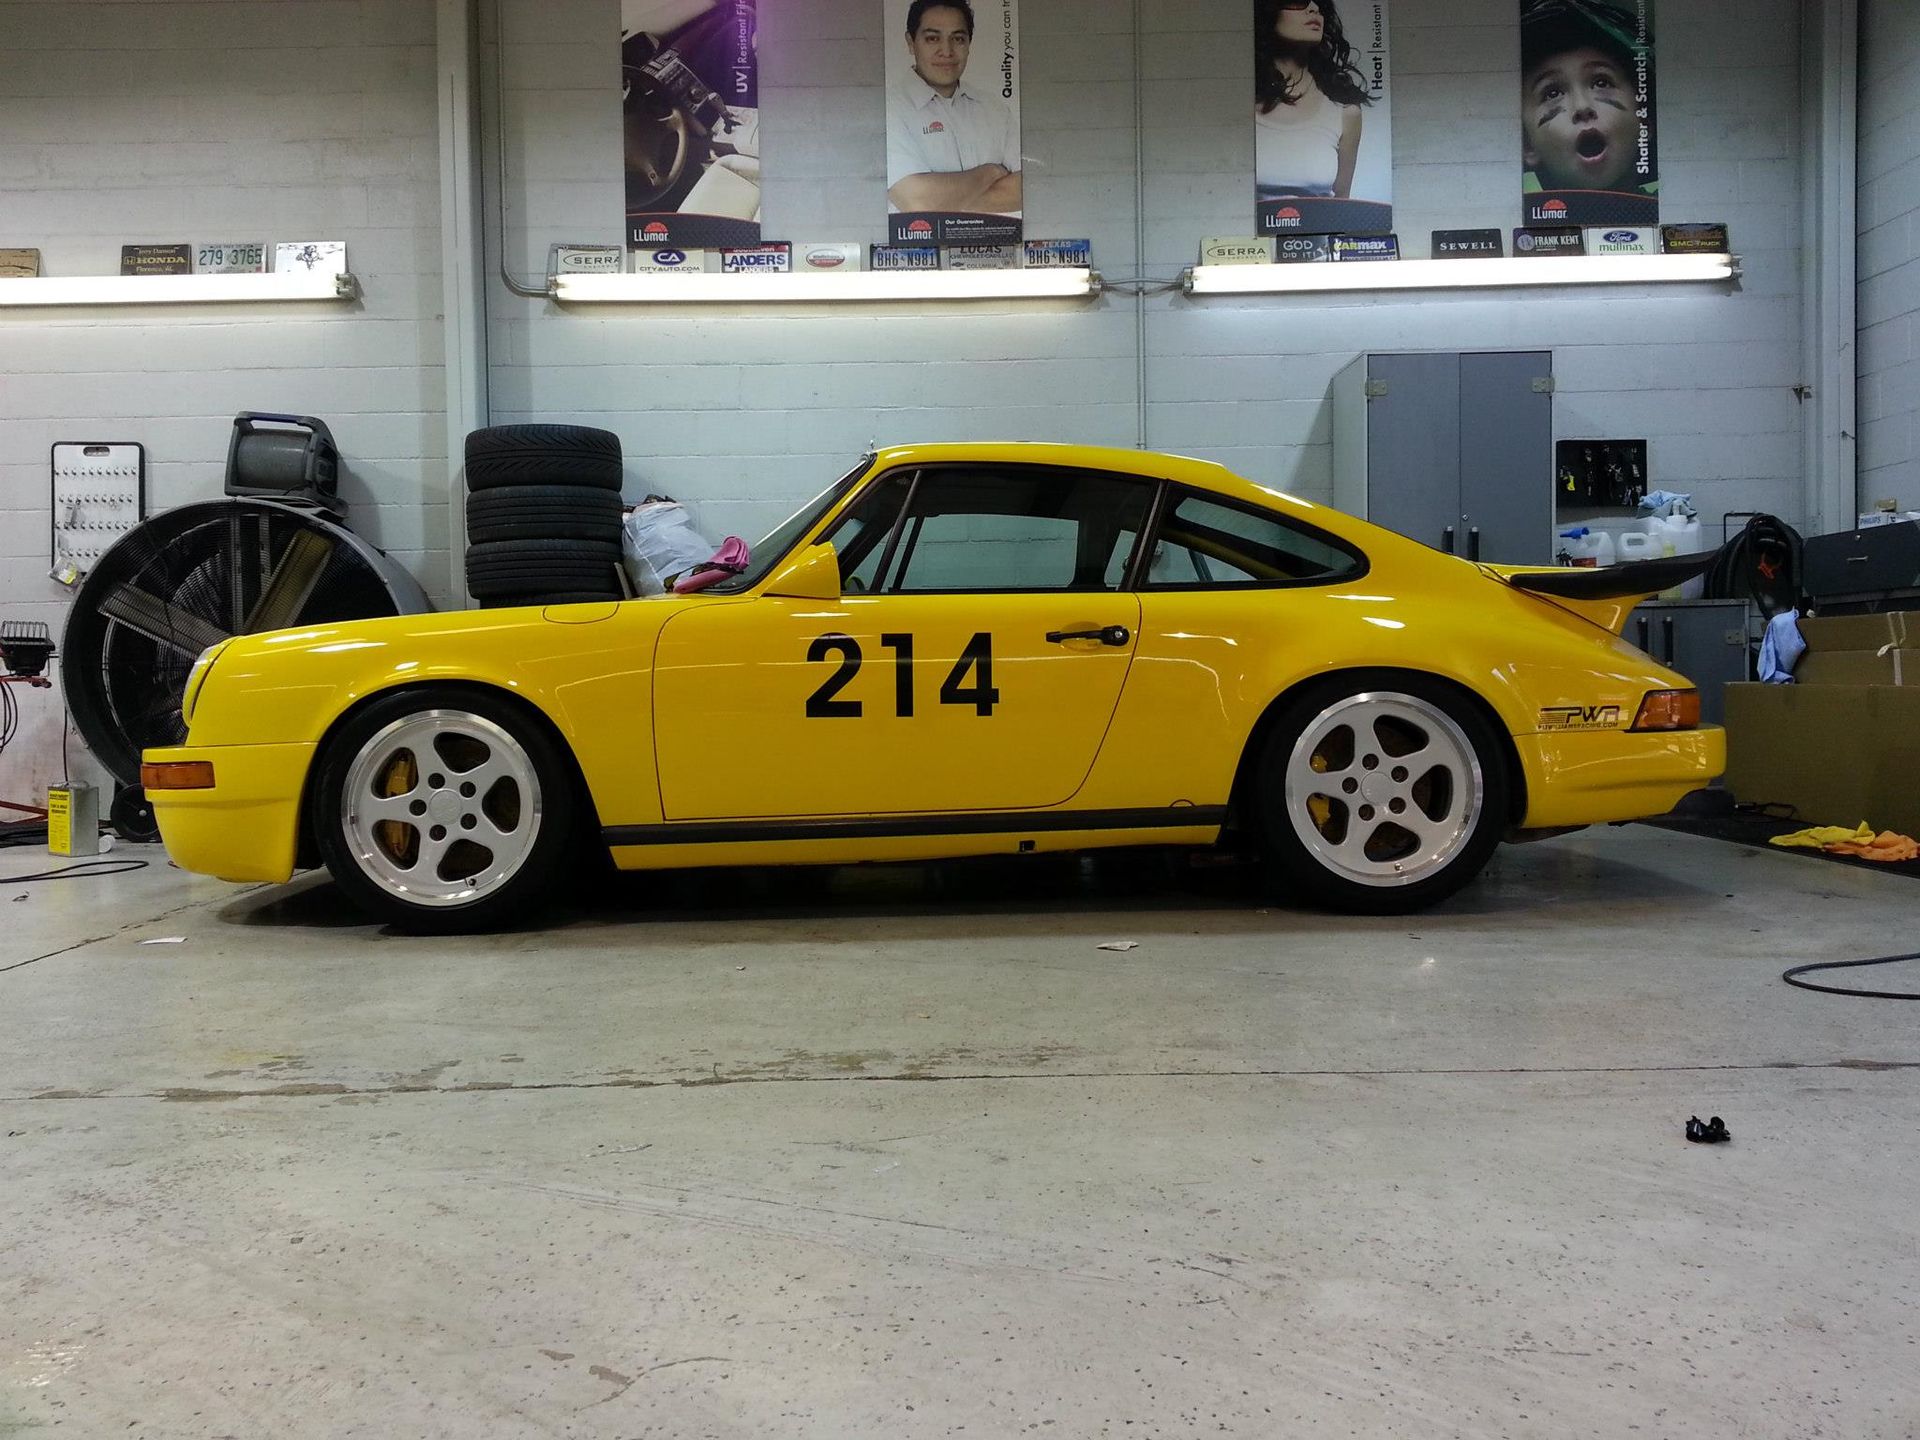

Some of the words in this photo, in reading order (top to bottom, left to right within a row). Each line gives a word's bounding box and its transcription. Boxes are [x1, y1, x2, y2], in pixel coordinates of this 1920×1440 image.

[1372, 4, 1382, 48] Resistant
[737, 19, 747, 63] Resistant
[1004, 32, 1014, 51] you
[1001, 53, 1014, 98] Quality
[1371, 56, 1383, 89] Heat
[1634, 51, 1647, 102] Scratch
[736, 71, 748, 93] UV
[1636, 107, 1648, 118] &
[1636, 123, 1649, 173] Shatter
[1532, 206, 1568, 219] LLumar
[1265, 214, 1301, 228] LLumar
[633, 228, 670, 242] LLumar
[898, 227, 933, 240] LLumar
[1534, 236, 1559, 246] FRANK
[1560, 235, 1579, 245] KENT
[1217, 247, 1266, 256] SERRA
[1283, 239, 1313, 251] GOD
[1440, 242, 1496, 250] SEWELL
[1599, 243, 1645, 251] mullinax
[136, 256, 186, 264] HONDA
[199, 249, 224, 265] 279
[231, 248, 263, 265] 3765
[657, 252, 681, 262] CA
[908, 252, 936, 267] N981
[1059, 249, 1087, 264] N981
[806, 632, 999, 717] 214
